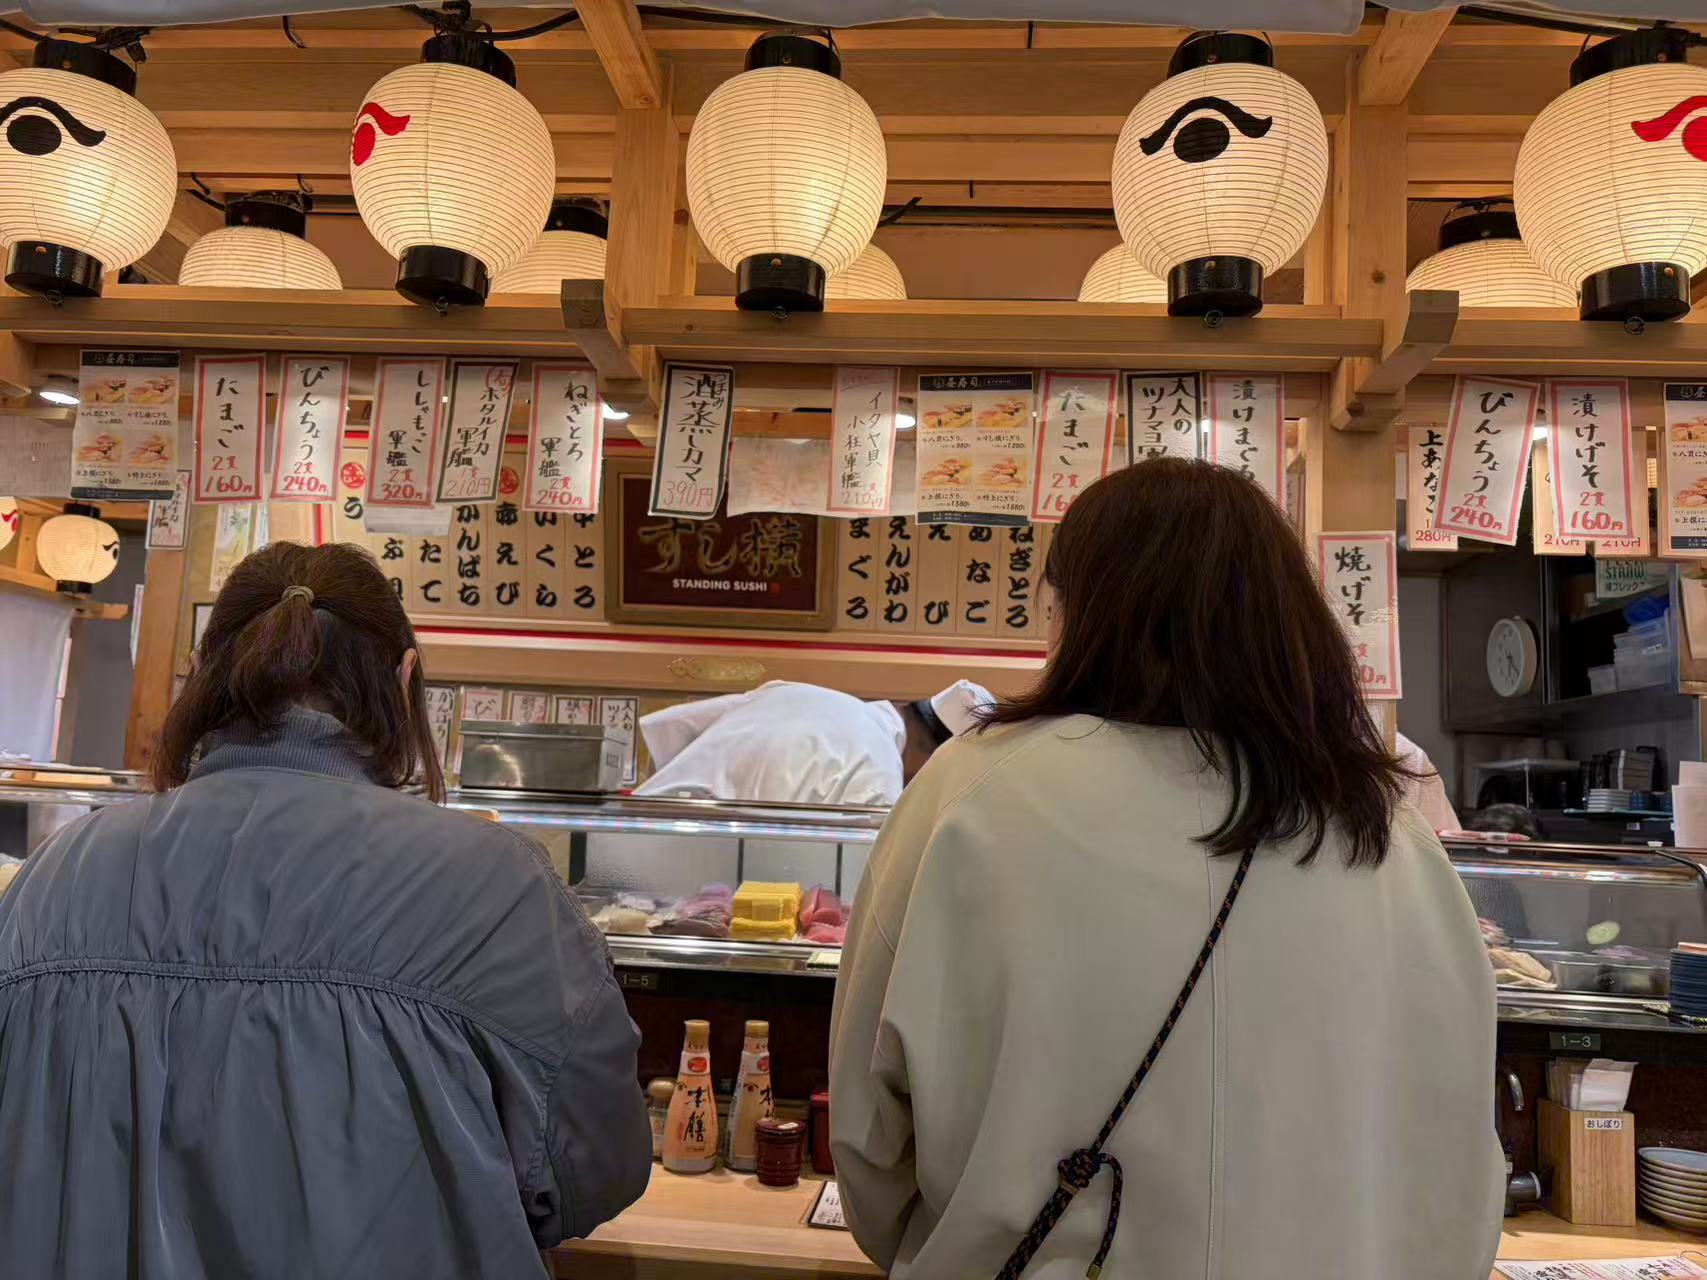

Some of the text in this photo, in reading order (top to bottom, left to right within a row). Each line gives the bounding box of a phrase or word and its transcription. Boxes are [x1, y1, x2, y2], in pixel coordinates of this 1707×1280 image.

[216, 377, 244, 448] たまご
[299, 366, 330, 460] びんちょう
[473, 387, 499, 456] ホタルイカ
[565, 382, 588, 461] ねぎとろ
[677, 374, 720, 481] 酒蒸しカマ
[866, 392, 882, 467] イタヤ貝
[1059, 391, 1089, 466] たまご
[1168, 378, 1194, 435] 大人の
[386, 430, 408, 467] 軍艦
[447, 427, 478, 468] 軍艦
[538, 437, 561, 477] 軍艦
[842, 416, 864, 488] 小柱軍艦
[1472, 391, 1514, 492] びんちょう
[1572, 392, 1605, 488] 漬けげそ
[205, 475, 252, 493] 160円
[283, 475, 328, 492] 240円
[382, 483, 423, 499] 320円
[446, 477, 491, 496] 210円
[536, 490, 583, 506] 240円
[663, 480, 713, 506] 390円
[1042, 494, 1078, 512] 16
[1450, 506, 1502, 530] 240円
[1571, 511, 1623, 530] 160円
[420, 539, 442, 603] たて
[496, 501, 520, 605] 赤えび
[535, 512, 557, 607] いくら
[846, 517, 871, 619] まぐろ
[884, 516, 911, 623] えんがわ
[924, 523, 952, 625] えび
[1005, 525, 1033, 628] ねぎとろ
[673, 578, 767, 592] STANDING SUSHI
[1335, 546, 1371, 626] 焼げそ
[1560, 1035, 1591, 1047] 1-3
[683, 1086, 706, 1141] 本膳
[759, 1085, 775, 1117] 本
[1586, 1119, 1620, 1129] おしぼり
